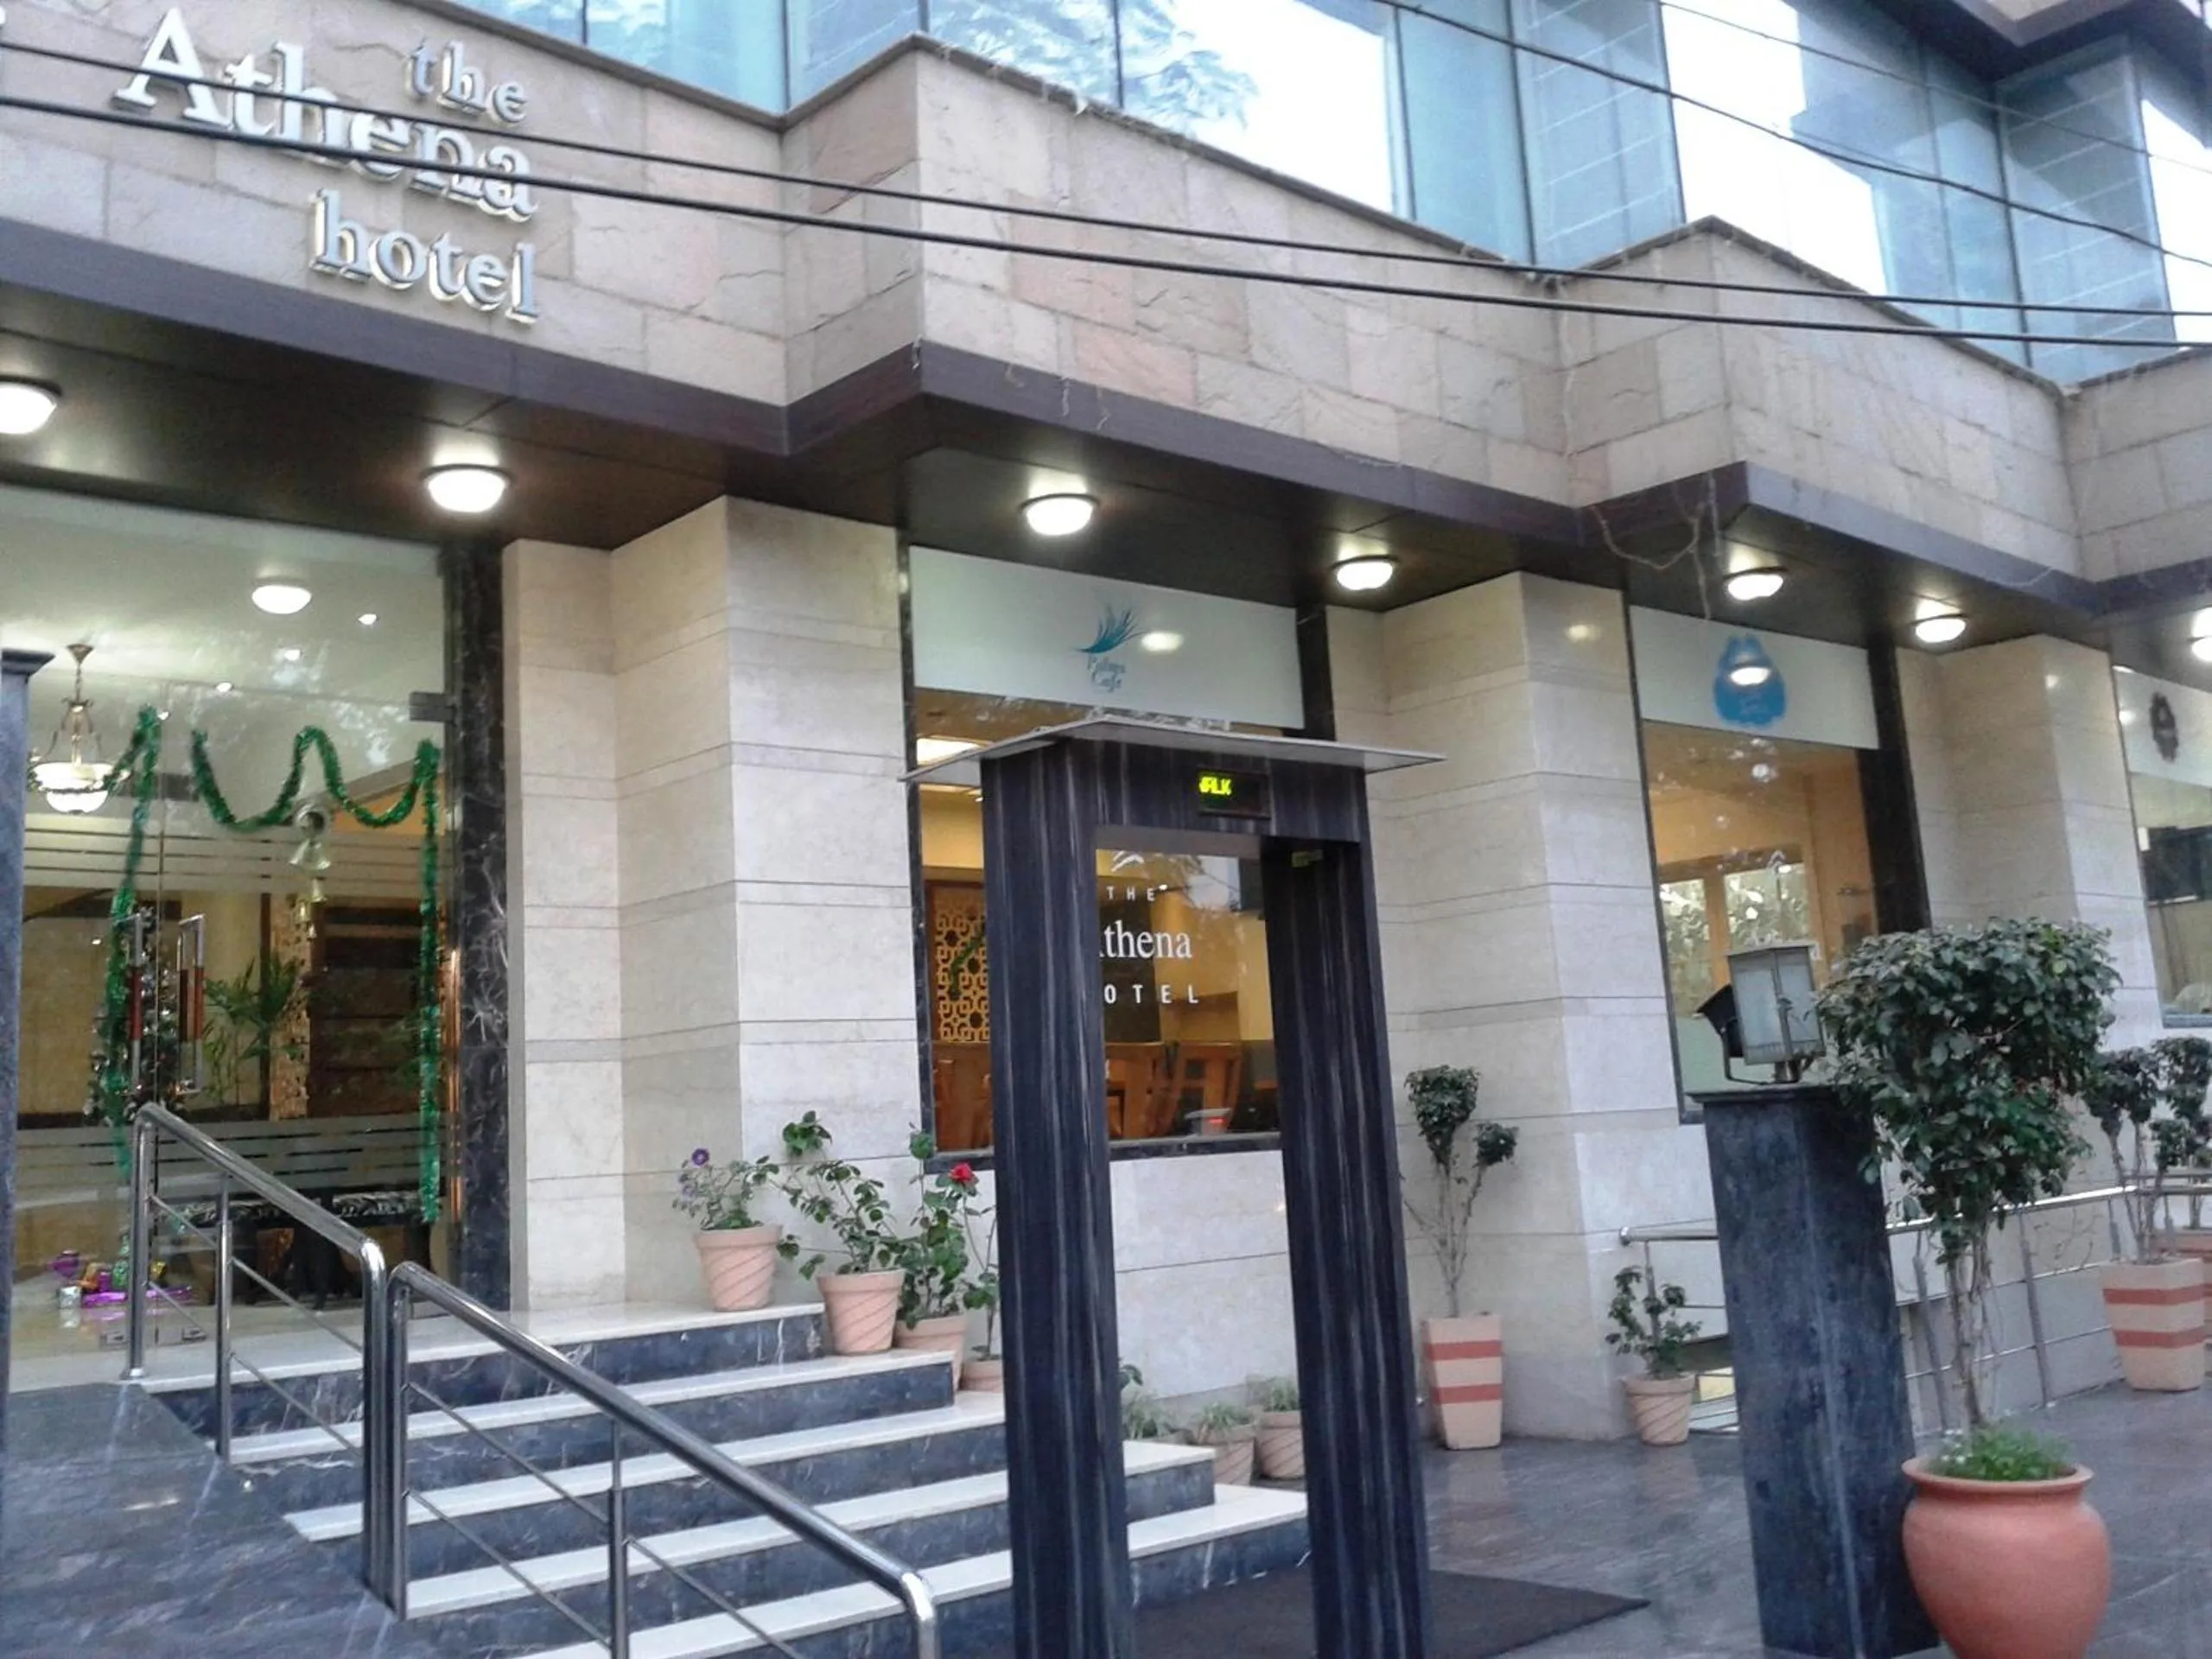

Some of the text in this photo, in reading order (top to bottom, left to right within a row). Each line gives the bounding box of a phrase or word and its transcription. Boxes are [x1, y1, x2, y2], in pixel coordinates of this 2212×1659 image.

[405, 38, 526, 124] the
[112, 7, 539, 222] Athena
[309, 188, 539, 324] hotel
[1106, 886, 1156, 902] THE
[1100, 919, 1192, 959] thena
[1103, 984, 1199, 1005] OTEL
